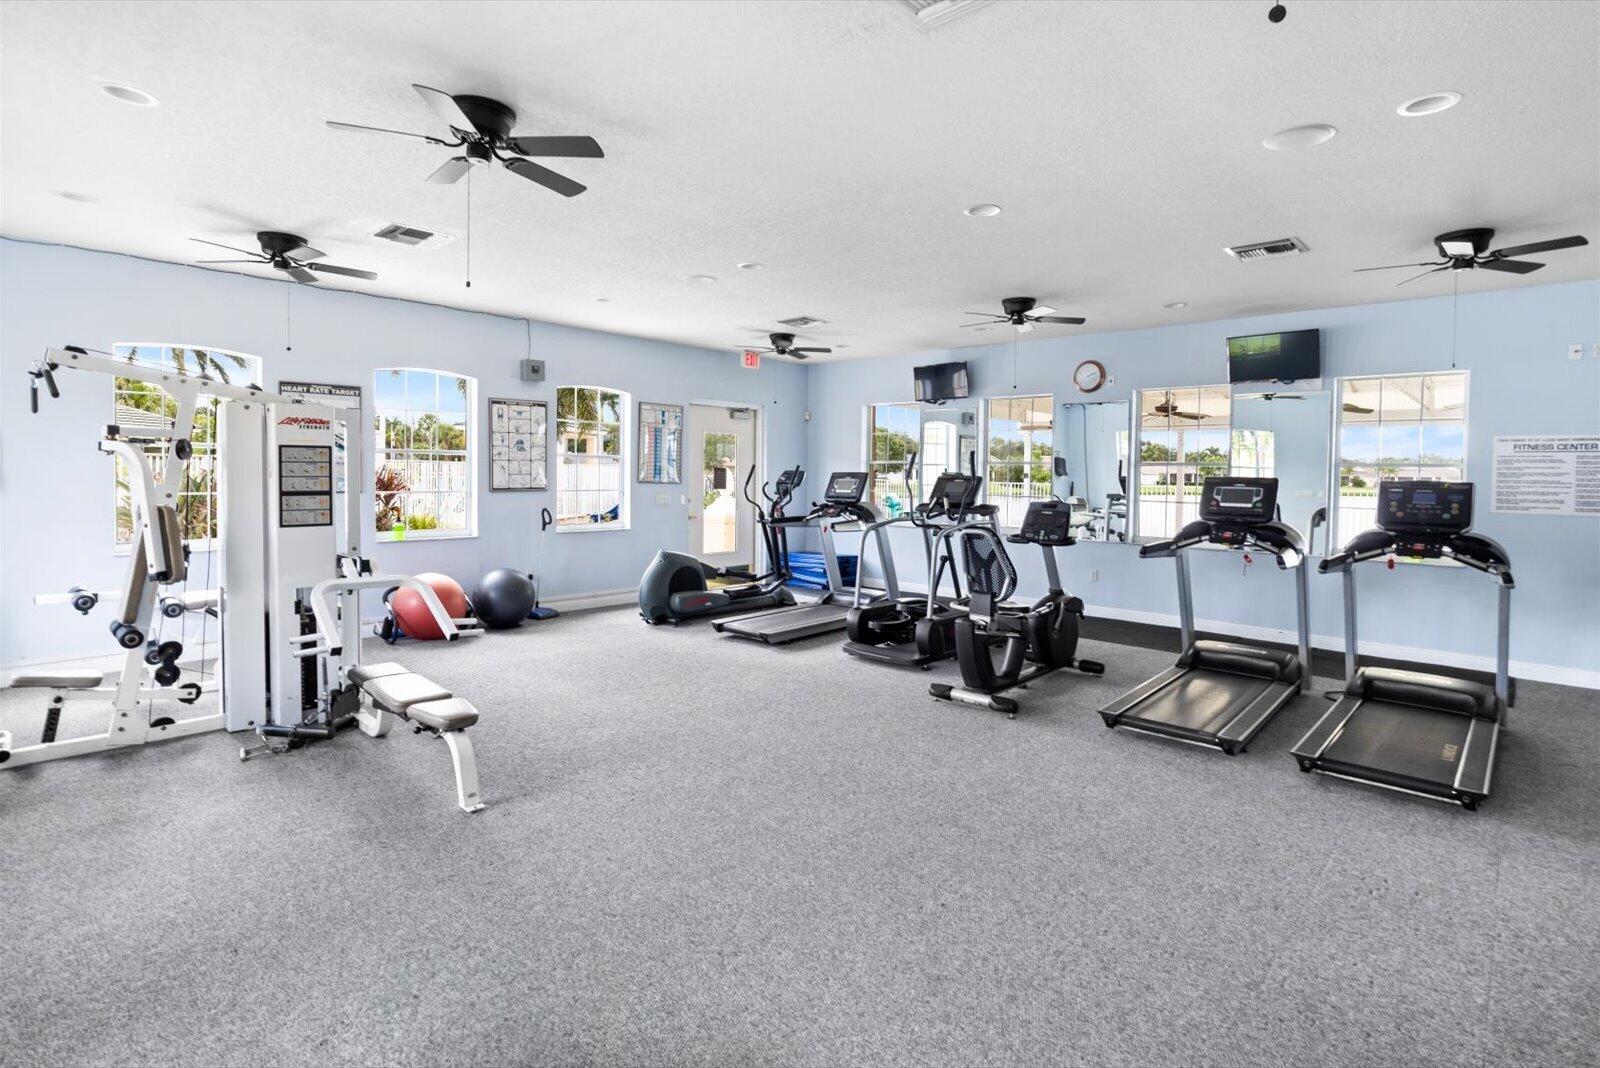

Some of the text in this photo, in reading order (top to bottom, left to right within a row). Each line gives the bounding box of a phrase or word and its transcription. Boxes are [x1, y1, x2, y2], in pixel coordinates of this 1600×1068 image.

[745, 352, 758, 366] EXIT
[281, 385, 308, 393] HEART
[1513, 442, 1598, 451] FITNESS CENTER
